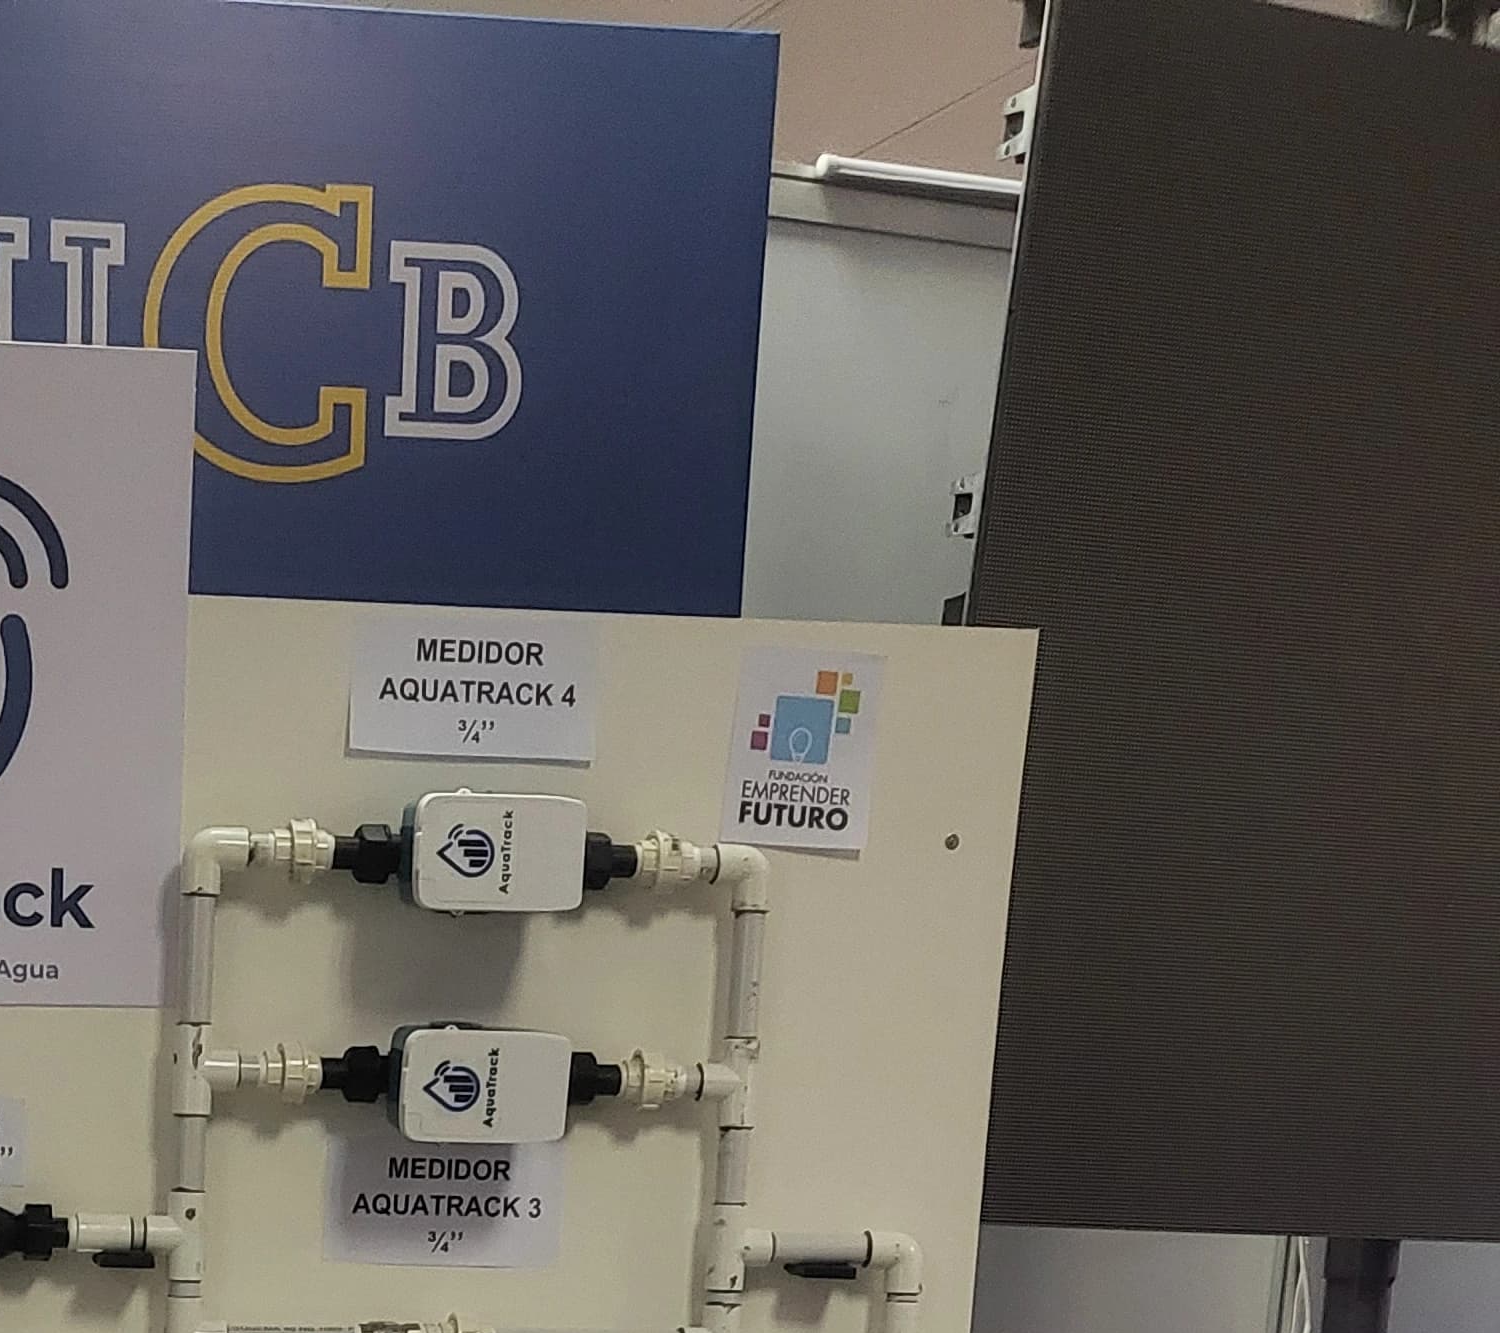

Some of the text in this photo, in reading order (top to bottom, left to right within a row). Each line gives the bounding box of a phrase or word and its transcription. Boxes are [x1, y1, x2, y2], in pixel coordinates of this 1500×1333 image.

[416, 638, 544, 666] MEDIDOR
[379, 677, 576, 708] AQUATRACK 4
[768, 769, 828, 785] FUNDACIÓN
[741, 781, 850, 805] EMPRENDER
[738, 802, 848, 831] FUTURO
[498, 810, 515, 894] AquaTrack
[483, 1047, 499, 1127] AquaTrack
[389, 1158, 510, 1181] MEDIDOR
[352, 1193, 541, 1218] AQUATRACK 3
